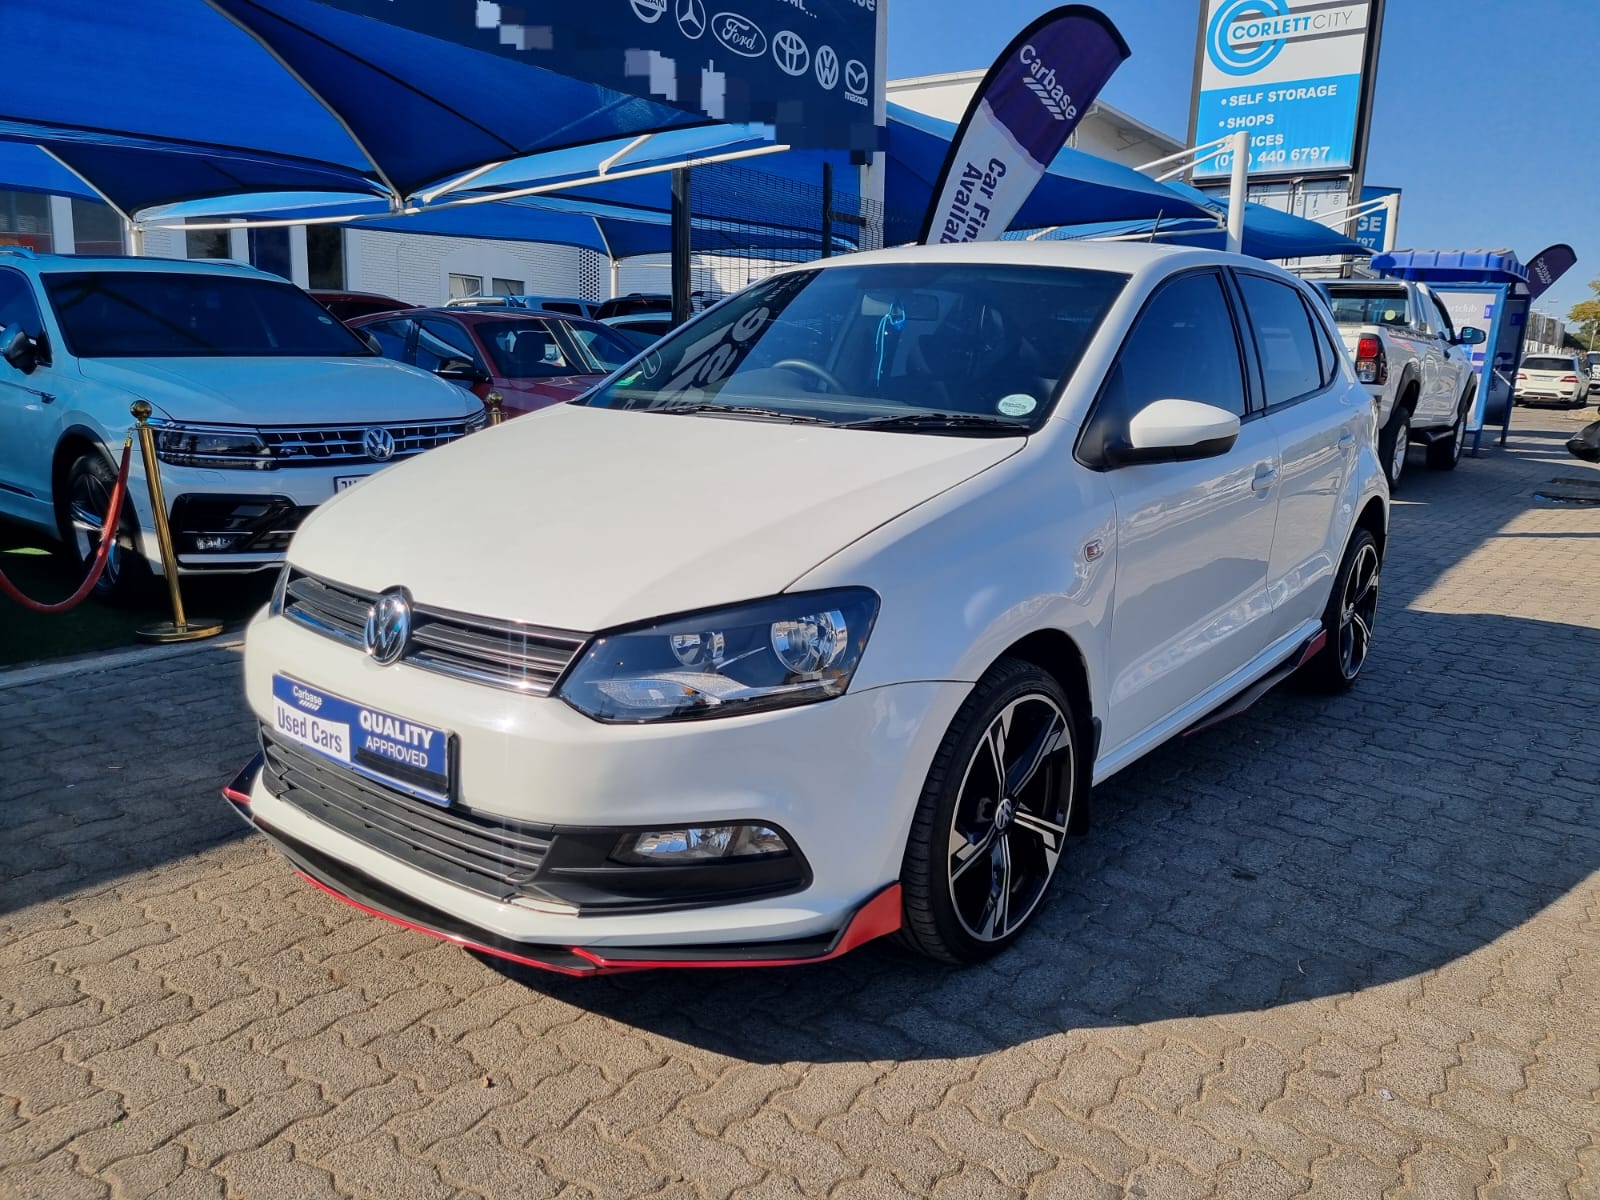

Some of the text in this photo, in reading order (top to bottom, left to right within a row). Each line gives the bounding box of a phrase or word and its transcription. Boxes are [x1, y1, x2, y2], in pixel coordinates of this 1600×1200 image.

[721, 17, 757, 50] Ford
[1019, 44, 1078, 120] Carbase
[1229, 84, 1338, 106] SELF STORAGE
[1227, 113, 1275, 129] SHOPS
[1257, 149, 1286, 163] 440
[1290, 146, 1331, 161] 6797
[982, 158, 1007, 200] Car
[292, 684, 323, 706] Carbase
[276, 705, 343, 754] Used Cars
[358, 709, 435, 750] QUALITY
[365, 734, 429, 769] APPROVED
